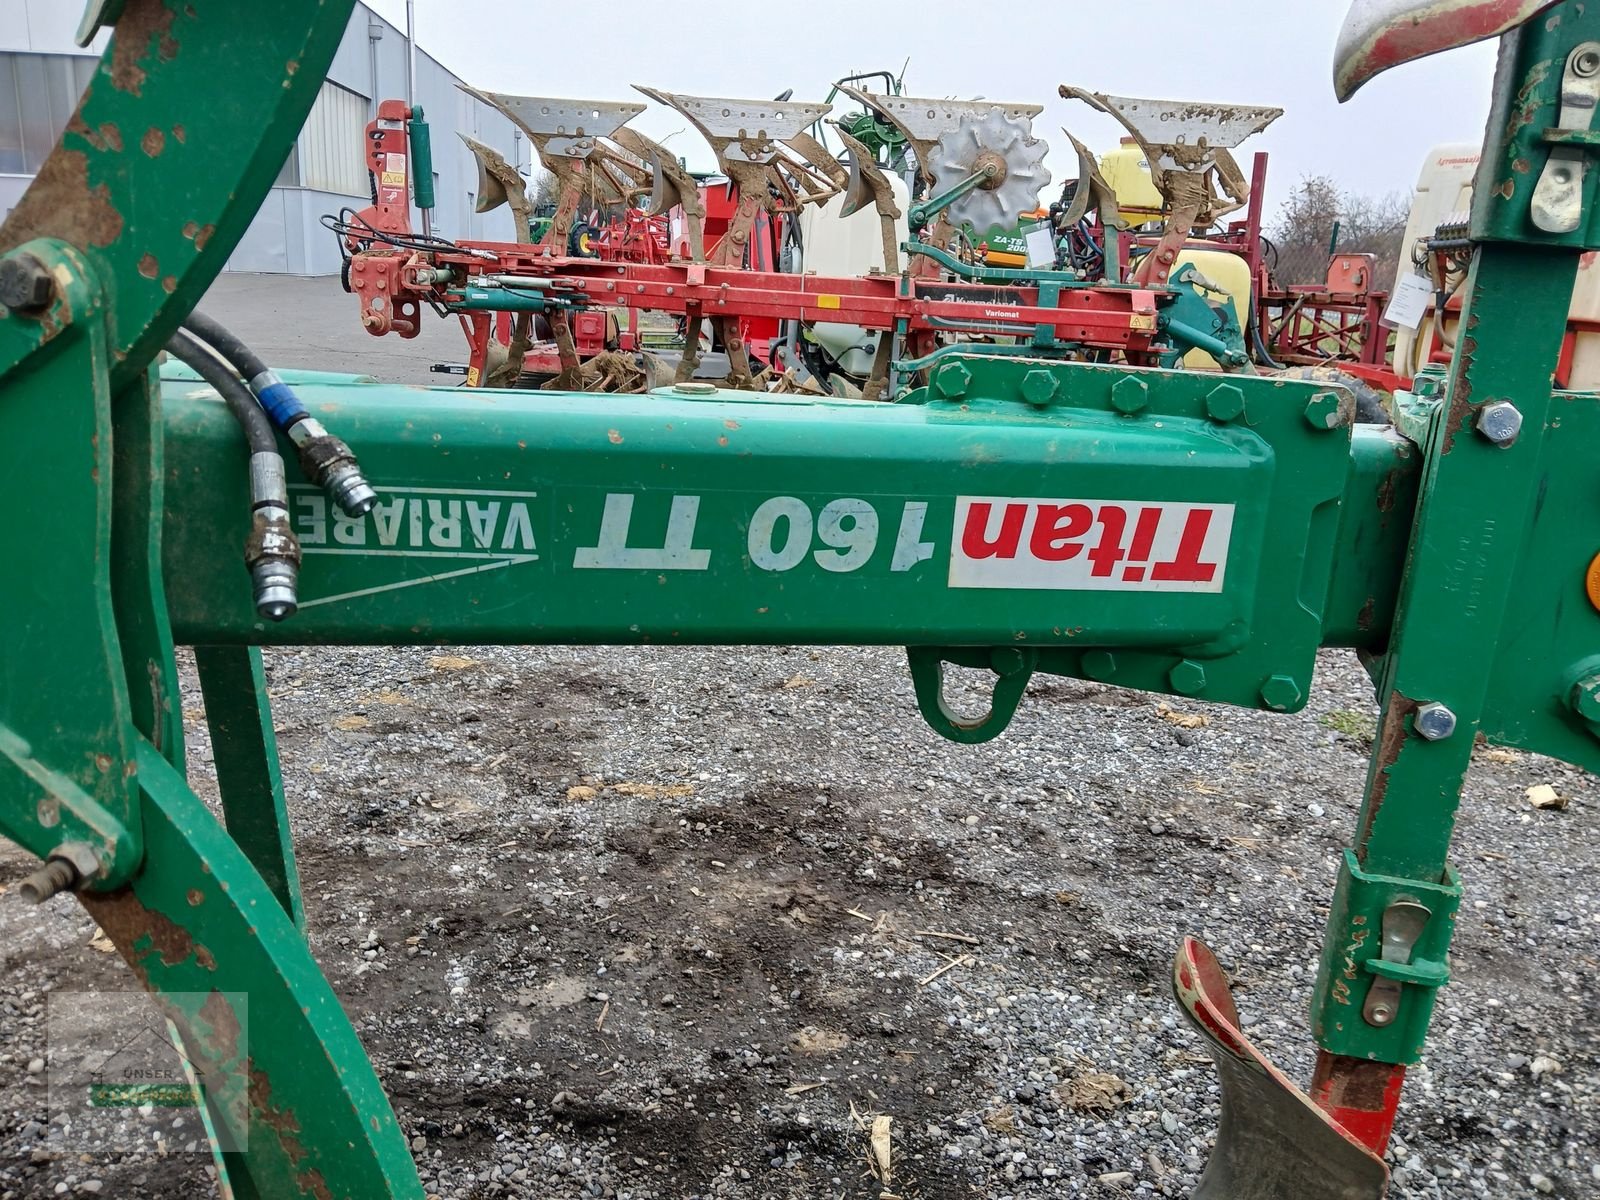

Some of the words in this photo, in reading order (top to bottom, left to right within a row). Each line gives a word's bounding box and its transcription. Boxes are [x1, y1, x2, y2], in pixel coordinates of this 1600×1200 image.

[994, 235, 1024, 245] ZA-TS
[1006, 244, 1028, 253] 200
[985, 309, 1020, 318] Variomat
[287, 495, 537, 549] VARIABE
[573, 493, 712, 570] TT
[747, 496, 935, 572] 160
[962, 502, 1217, 582] Titan
